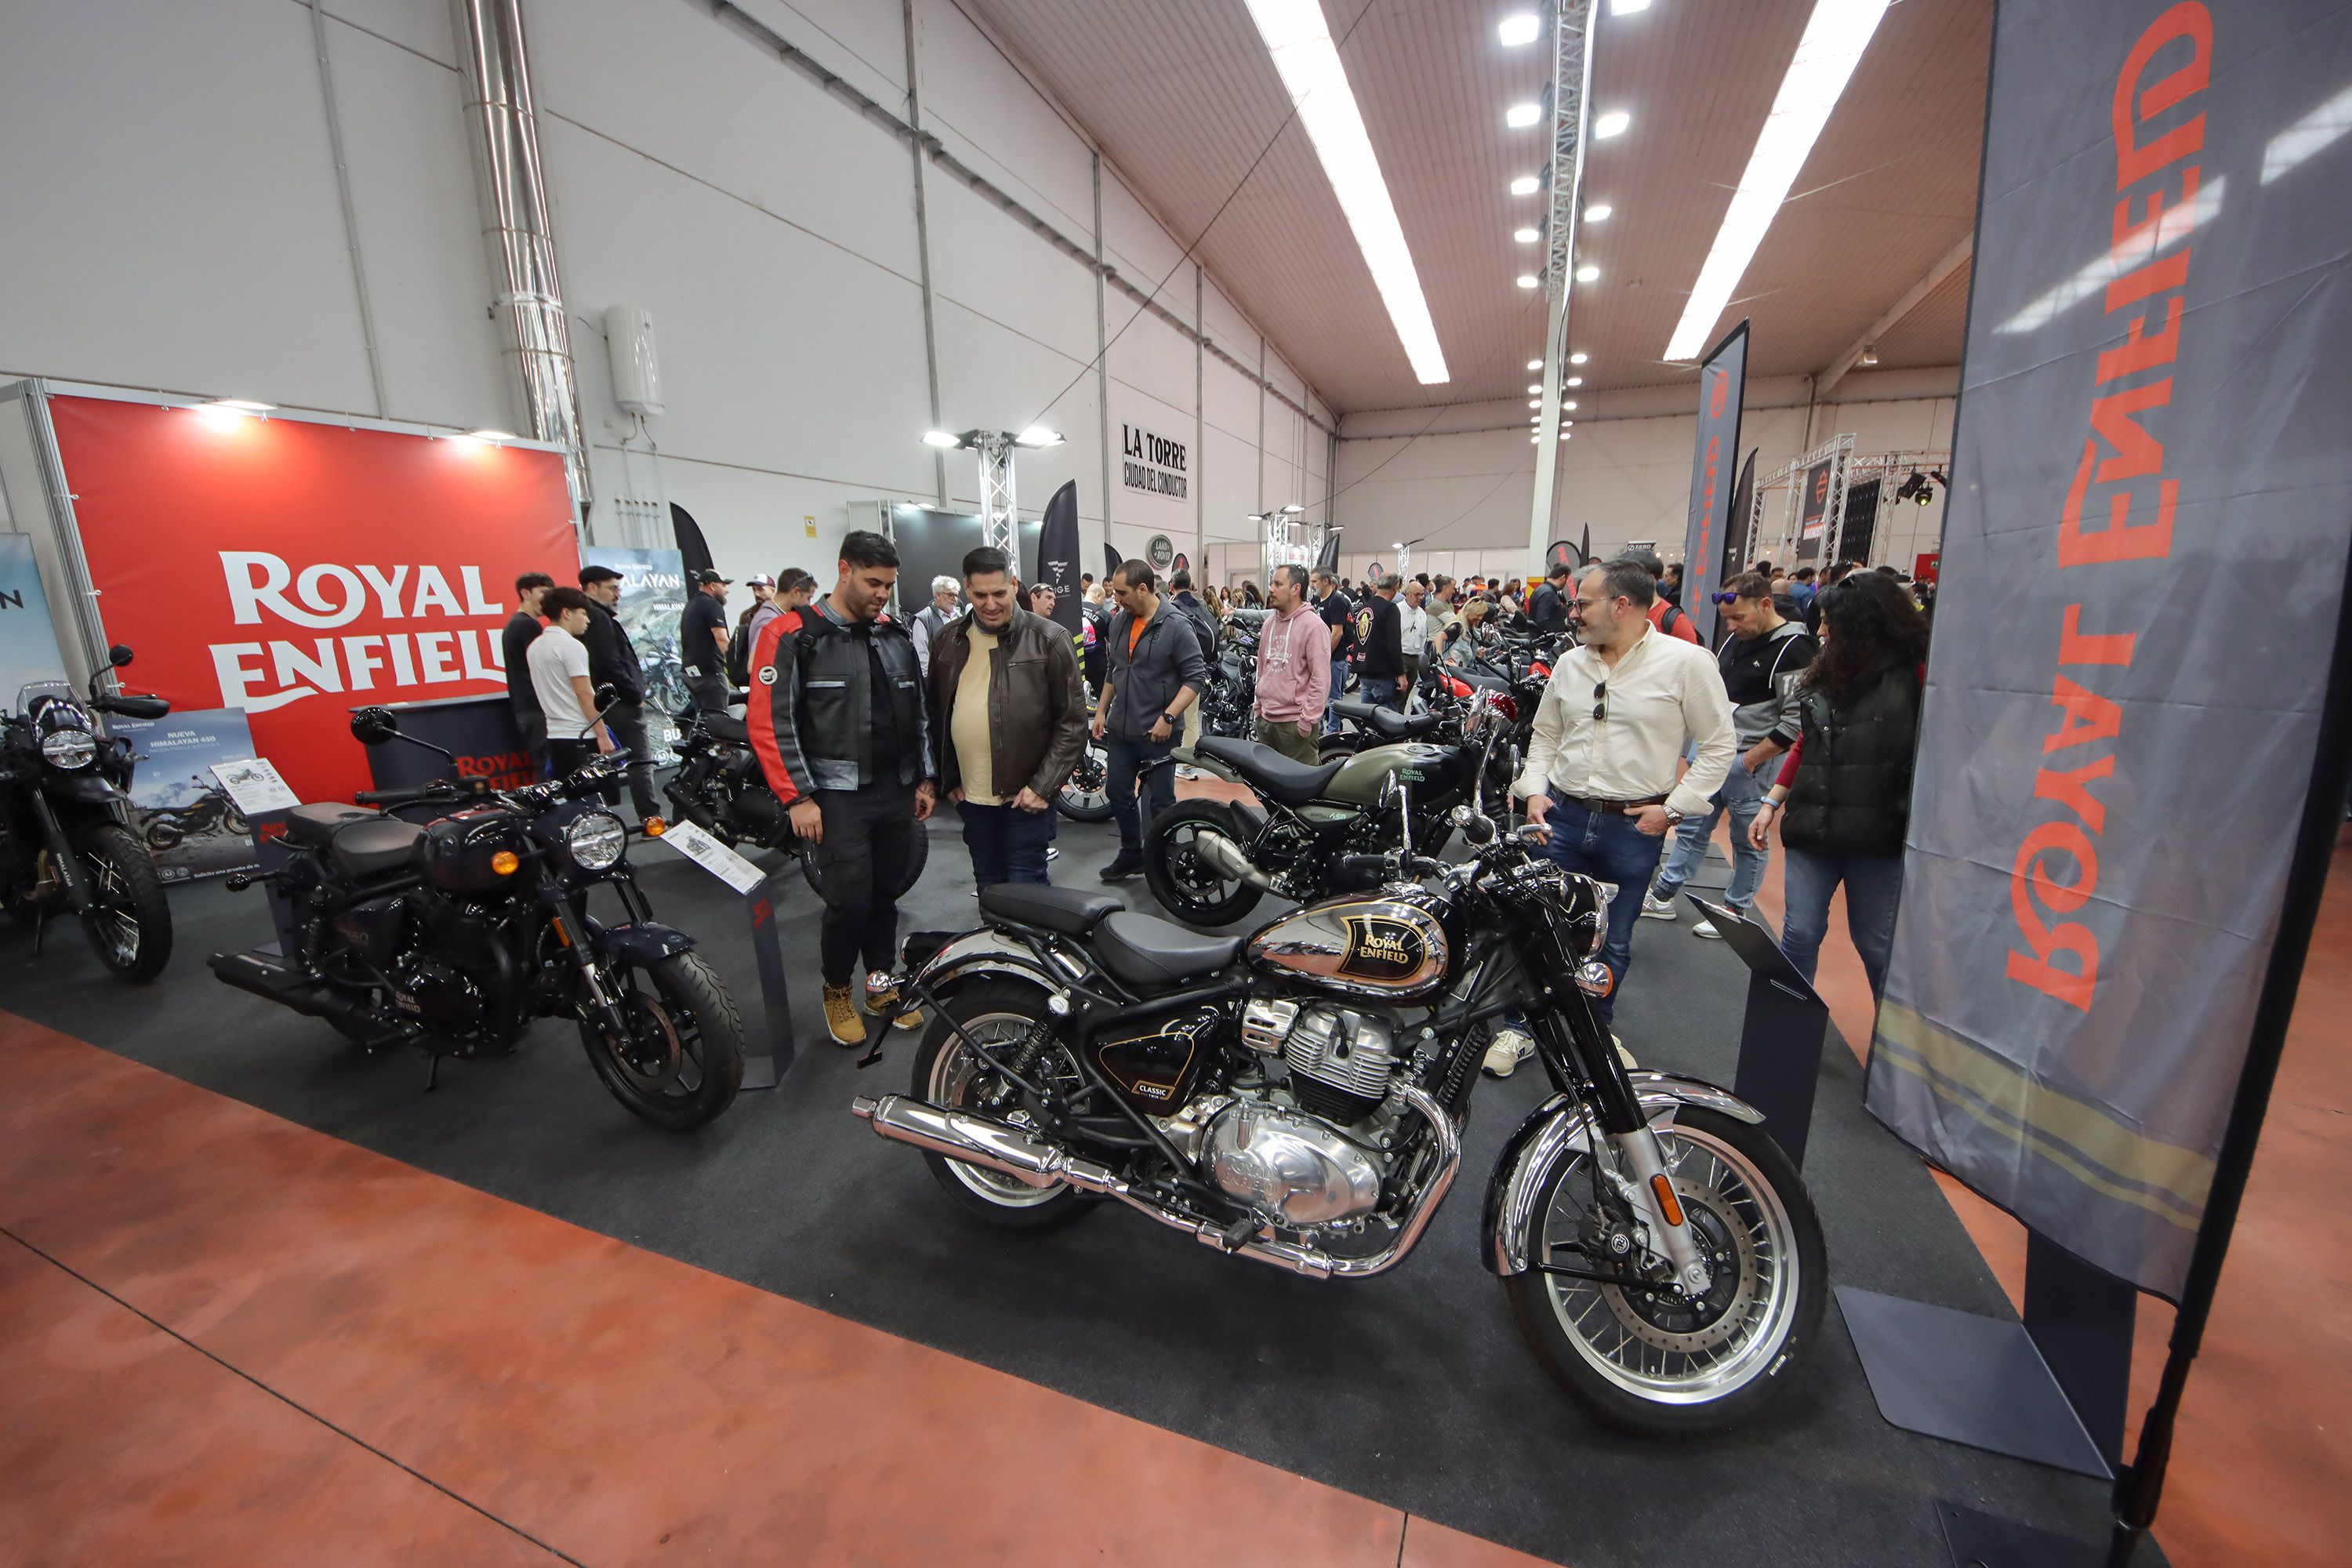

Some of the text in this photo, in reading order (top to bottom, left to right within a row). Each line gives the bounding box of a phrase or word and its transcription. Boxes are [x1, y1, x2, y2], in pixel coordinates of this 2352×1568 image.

[1123, 423, 1186, 471] LA TORRE
[1124, 461, 1187, 499] CIUDAD DEL CONDUCTOR
[1156, 541, 1167, 550] LAND
[1156, 550, 1171, 561] ROVER
[619, 573, 681, 590] ALAYAN
[218, 550, 503, 629] ROYAL
[167, 730, 196, 739] NUEVA
[150, 737, 199, 748] HIMALAYAN
[1402, 768, 1423, 776] ROYAL
[1365, 934, 1404, 952] ROYAL
[1359, 946, 1409, 964] ENFIELD
[395, 990, 416, 1004] ROYAL
[1139, 1084, 1167, 1096] CLASSIC
